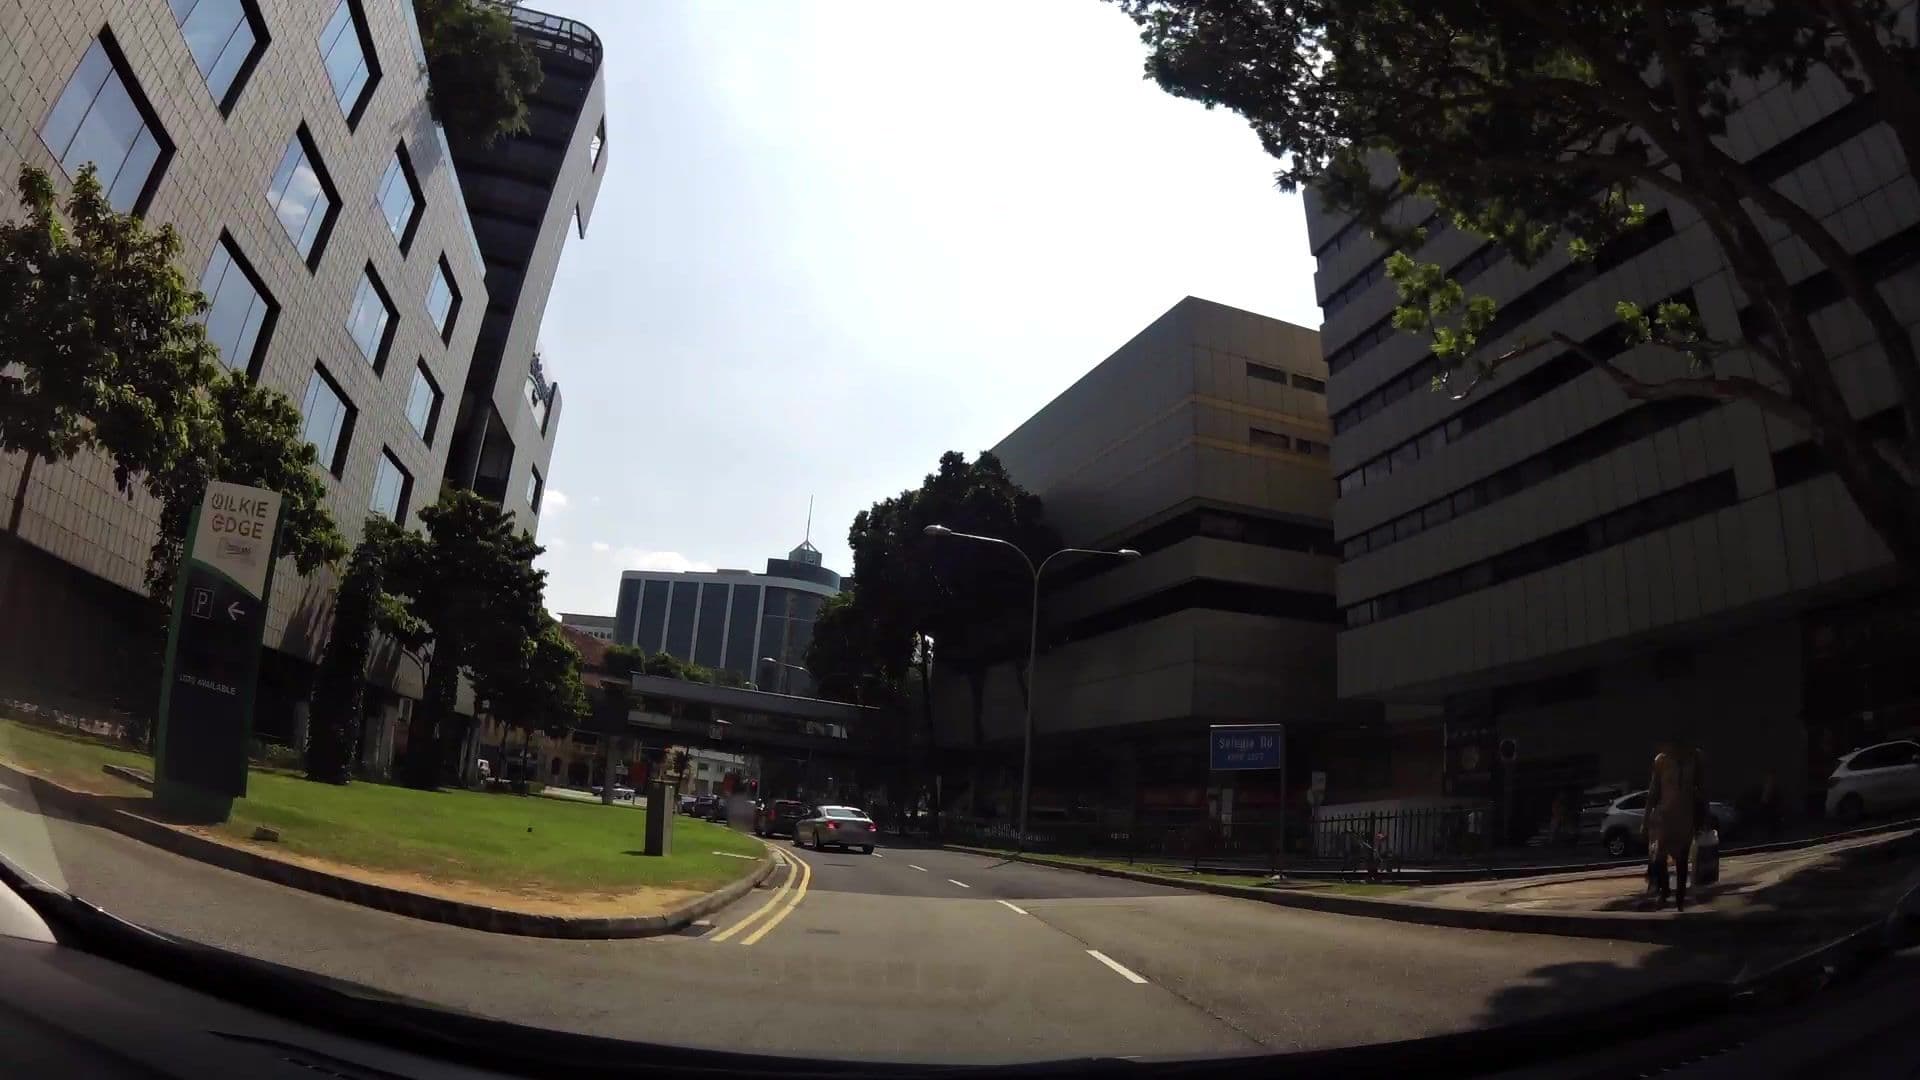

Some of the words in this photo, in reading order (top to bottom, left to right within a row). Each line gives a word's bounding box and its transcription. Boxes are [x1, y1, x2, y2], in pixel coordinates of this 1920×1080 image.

[196, 591, 209, 614] P
[197, 679, 237, 695] AVAILABLE
[1260, 735, 1273, 749] Rd
